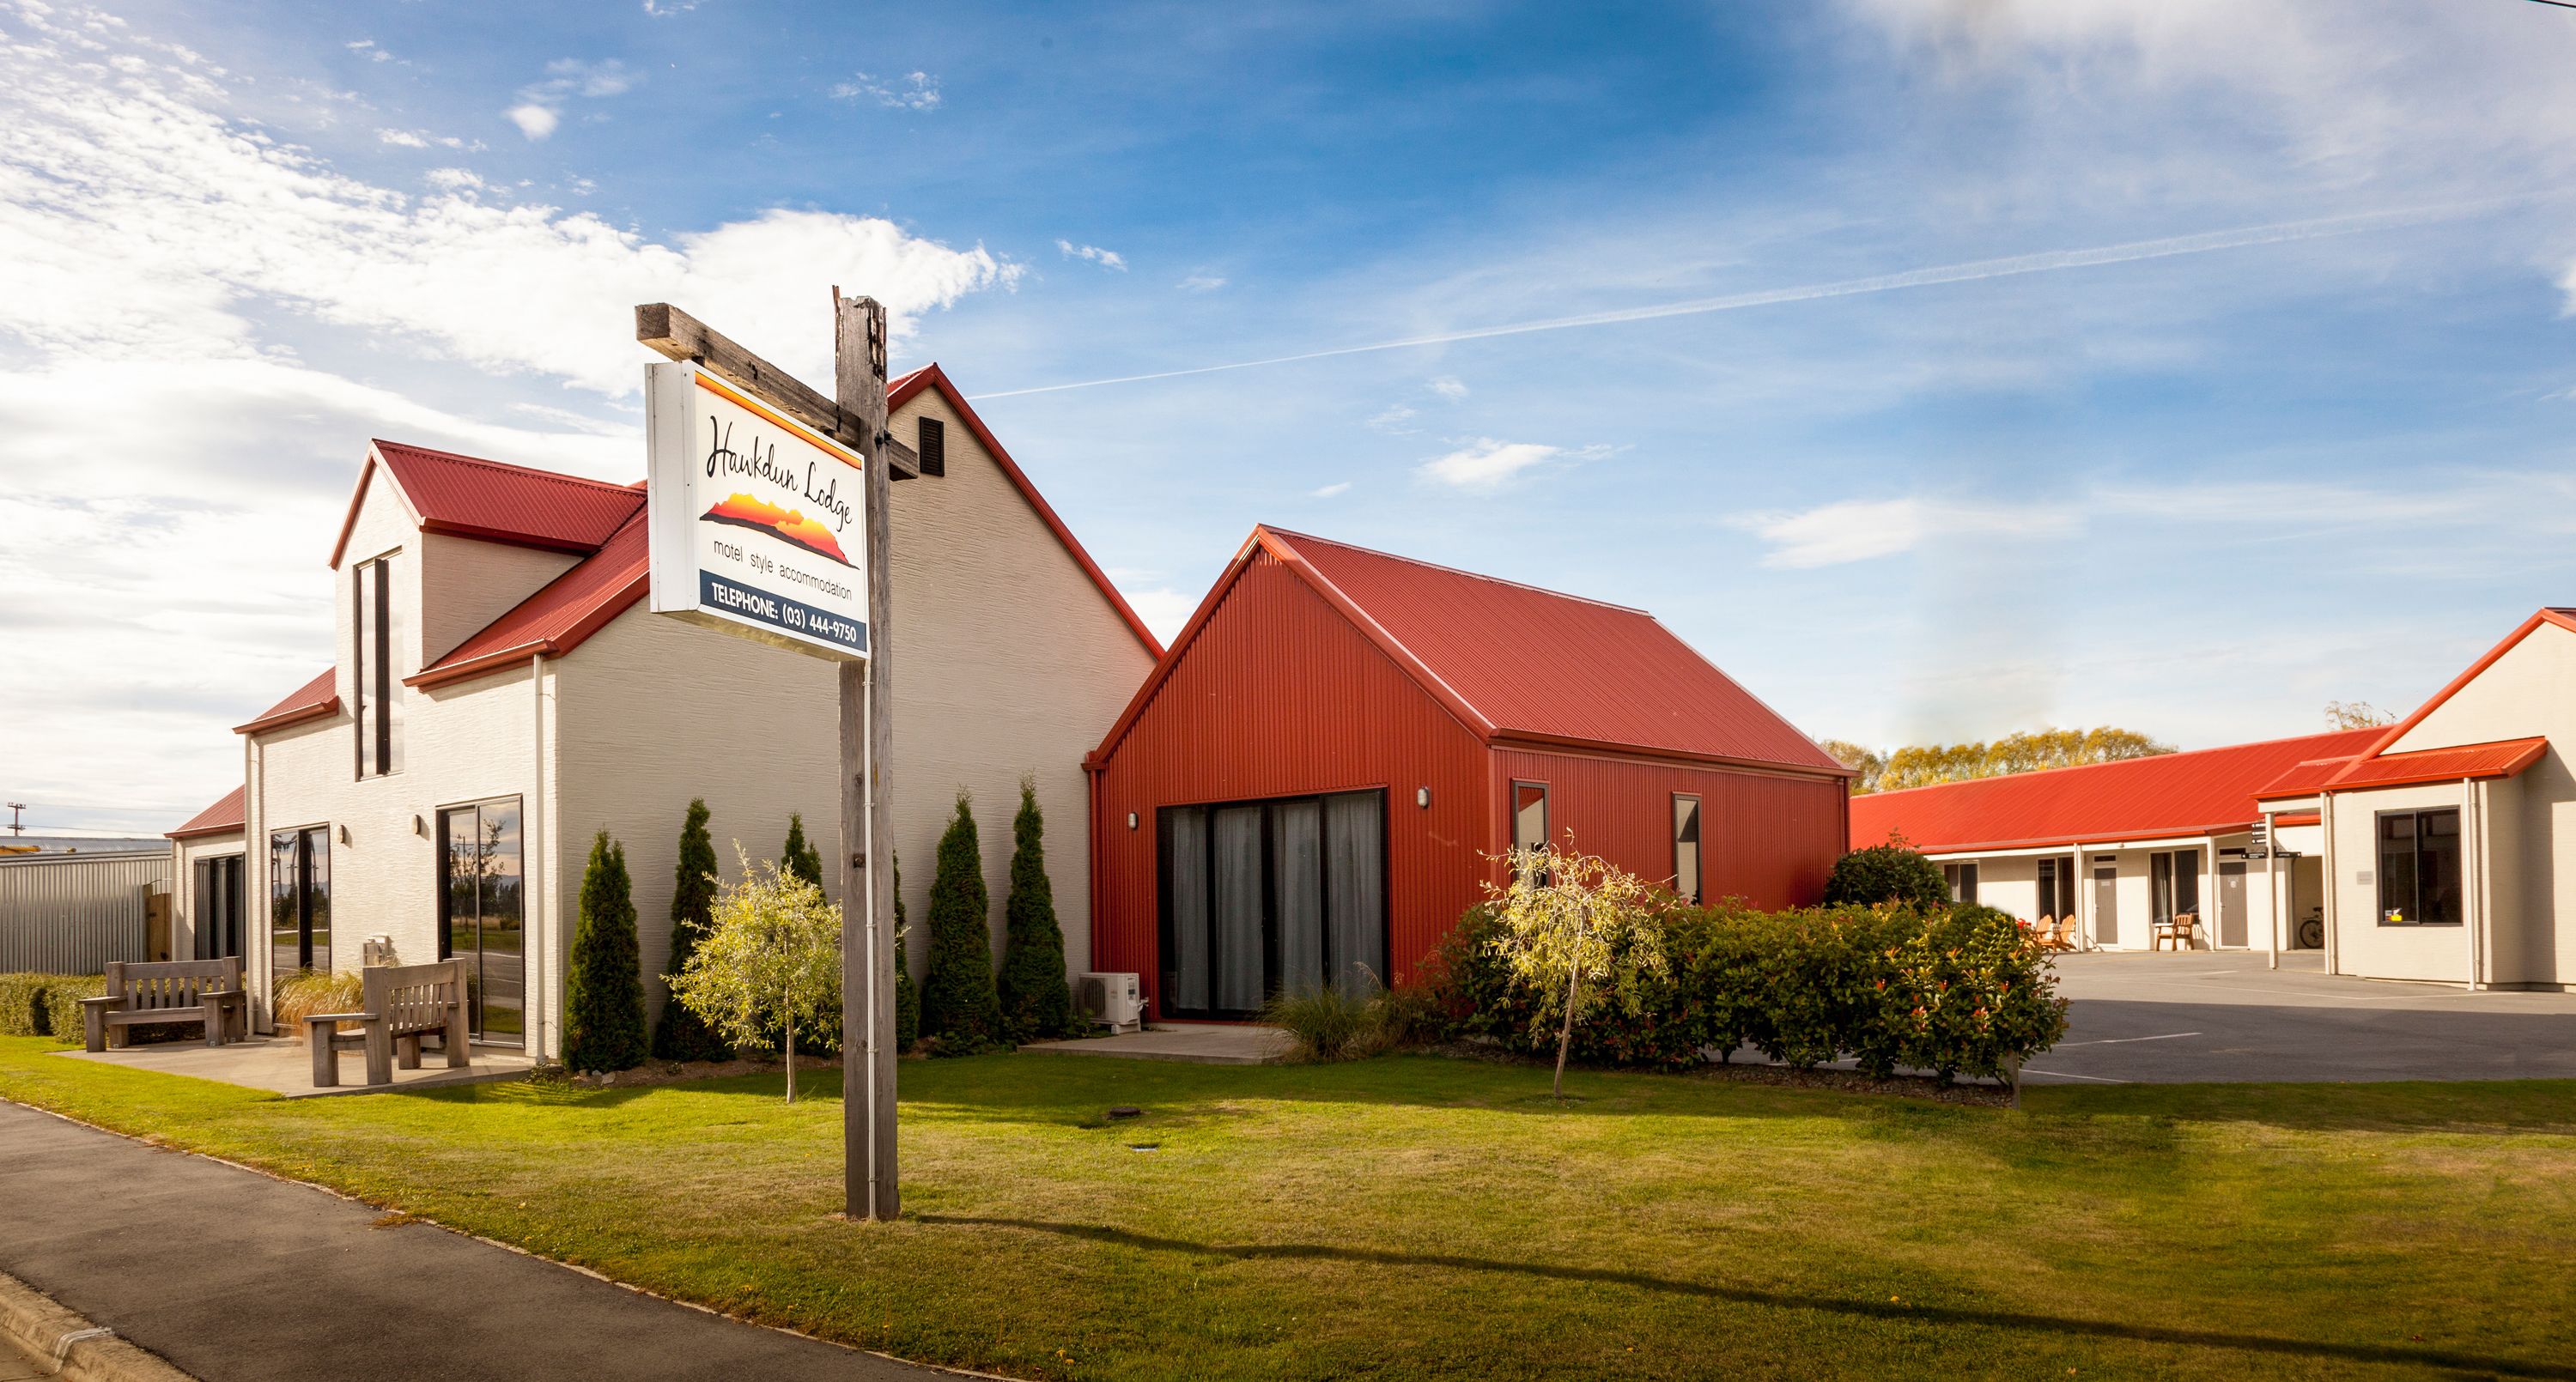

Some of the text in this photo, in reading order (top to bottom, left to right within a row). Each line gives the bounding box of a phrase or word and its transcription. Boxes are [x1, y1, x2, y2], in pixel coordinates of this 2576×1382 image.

[707, 415, 853, 532] Hawkdun Lodge
[714, 539, 853, 601] motel style accommodation
[711, 581, 857, 643] TELEPHONE: (03) 444-9750
